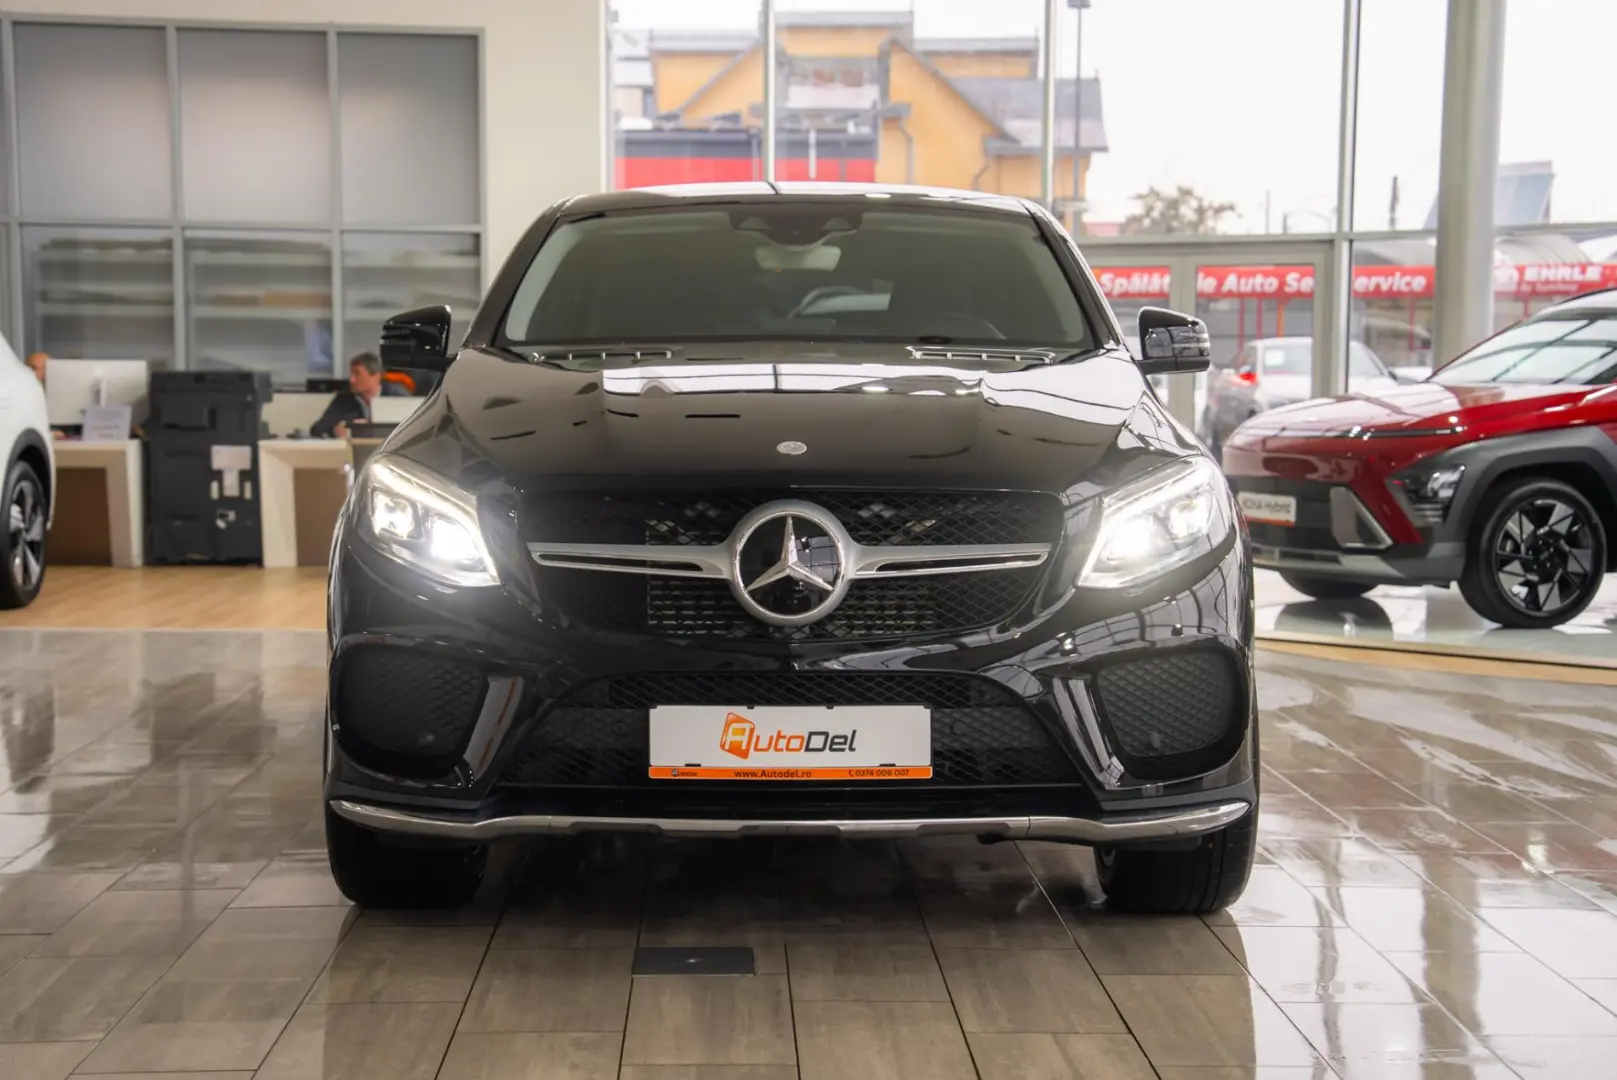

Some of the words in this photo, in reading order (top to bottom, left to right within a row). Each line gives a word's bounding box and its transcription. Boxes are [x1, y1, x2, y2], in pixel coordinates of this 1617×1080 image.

[1222, 272, 1279, 294] Auto
[1284, 272, 1315, 293] Se
[1353, 271, 1427, 293] ervice
[720, 715, 858, 757] AutoDel
[734, 769, 813, 779] www.Autodel.ro
